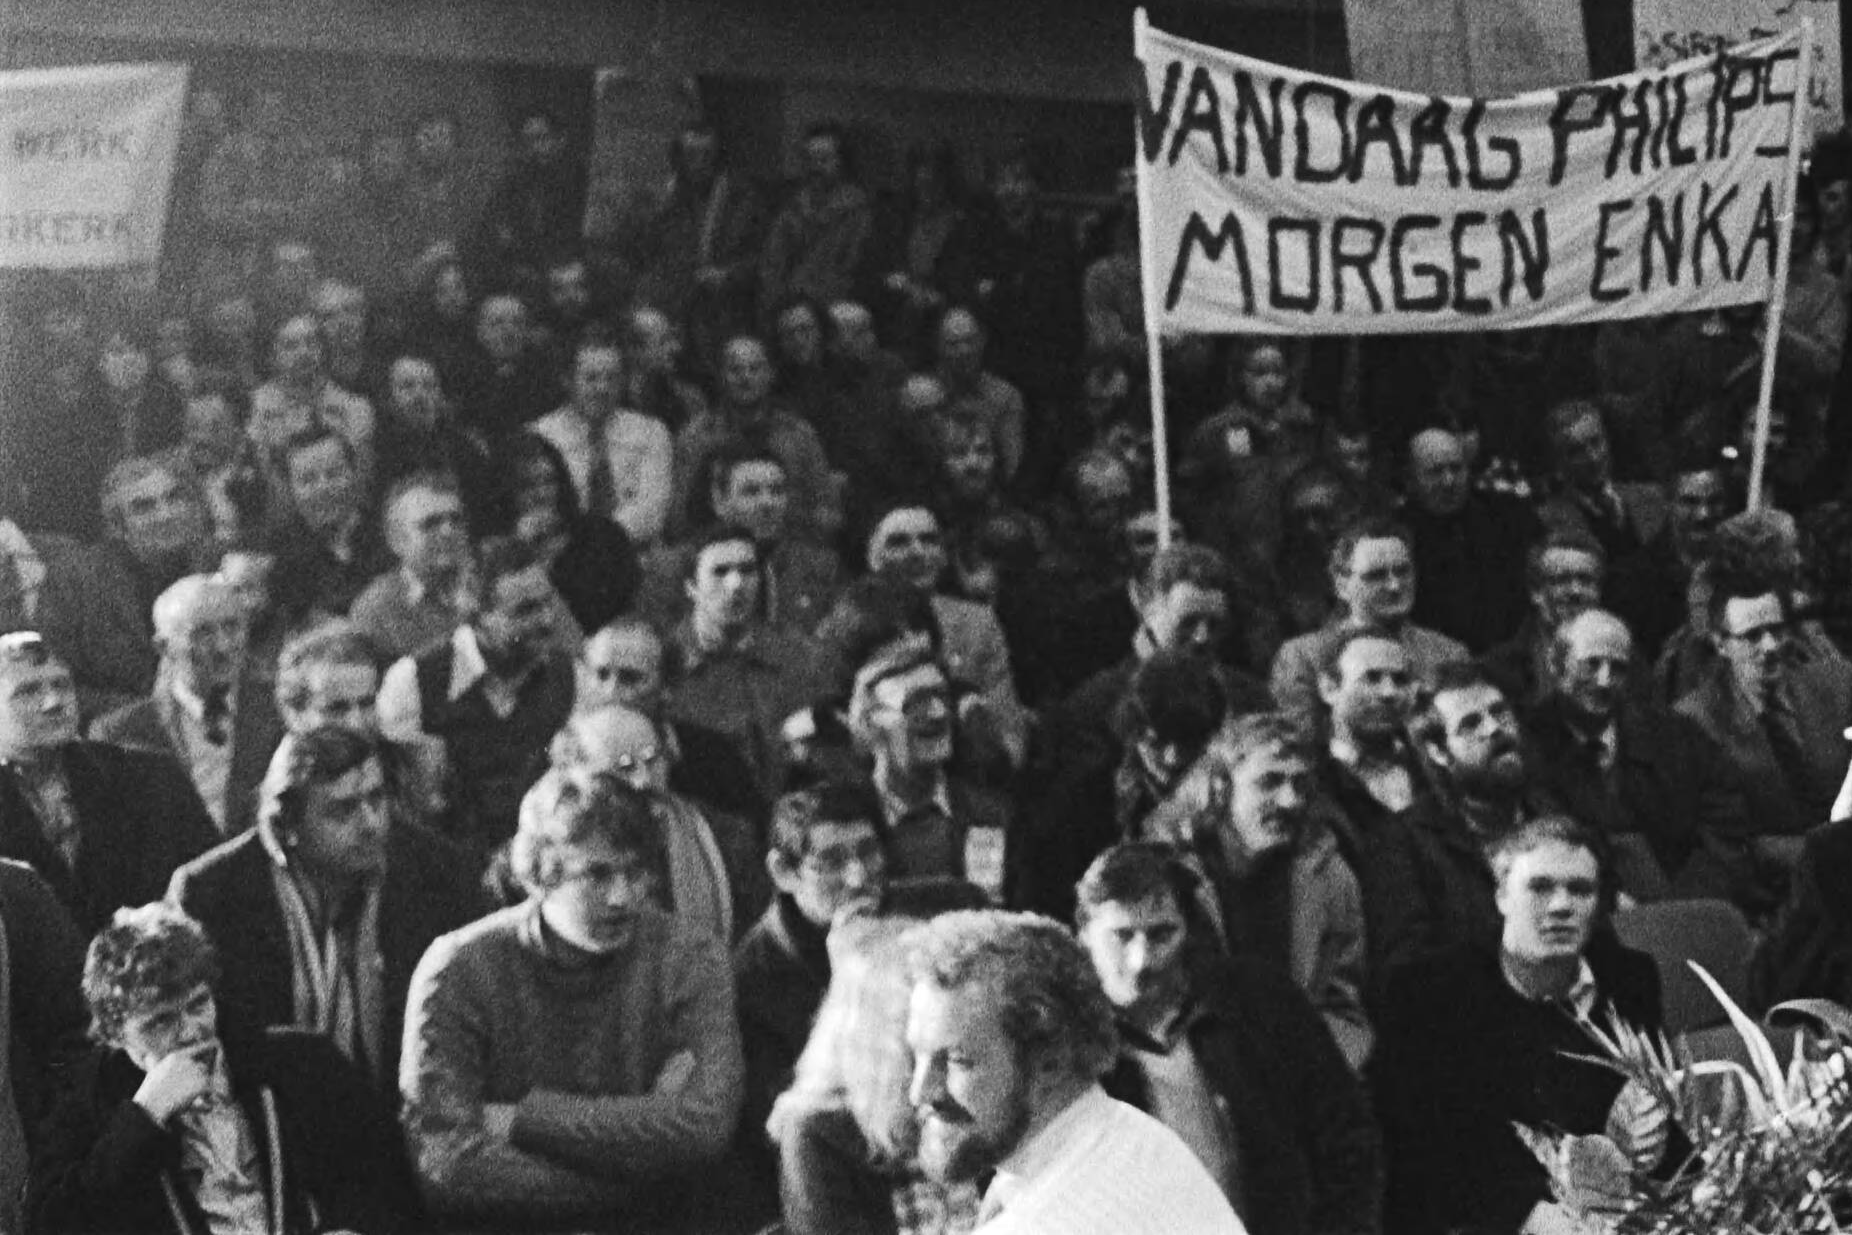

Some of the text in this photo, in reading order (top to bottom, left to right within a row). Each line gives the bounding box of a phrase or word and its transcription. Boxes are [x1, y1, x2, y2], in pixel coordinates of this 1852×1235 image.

[1138, 61, 1522, 191] VANDAAG
[1166, 180, 1779, 316] MORGEN ENKA
